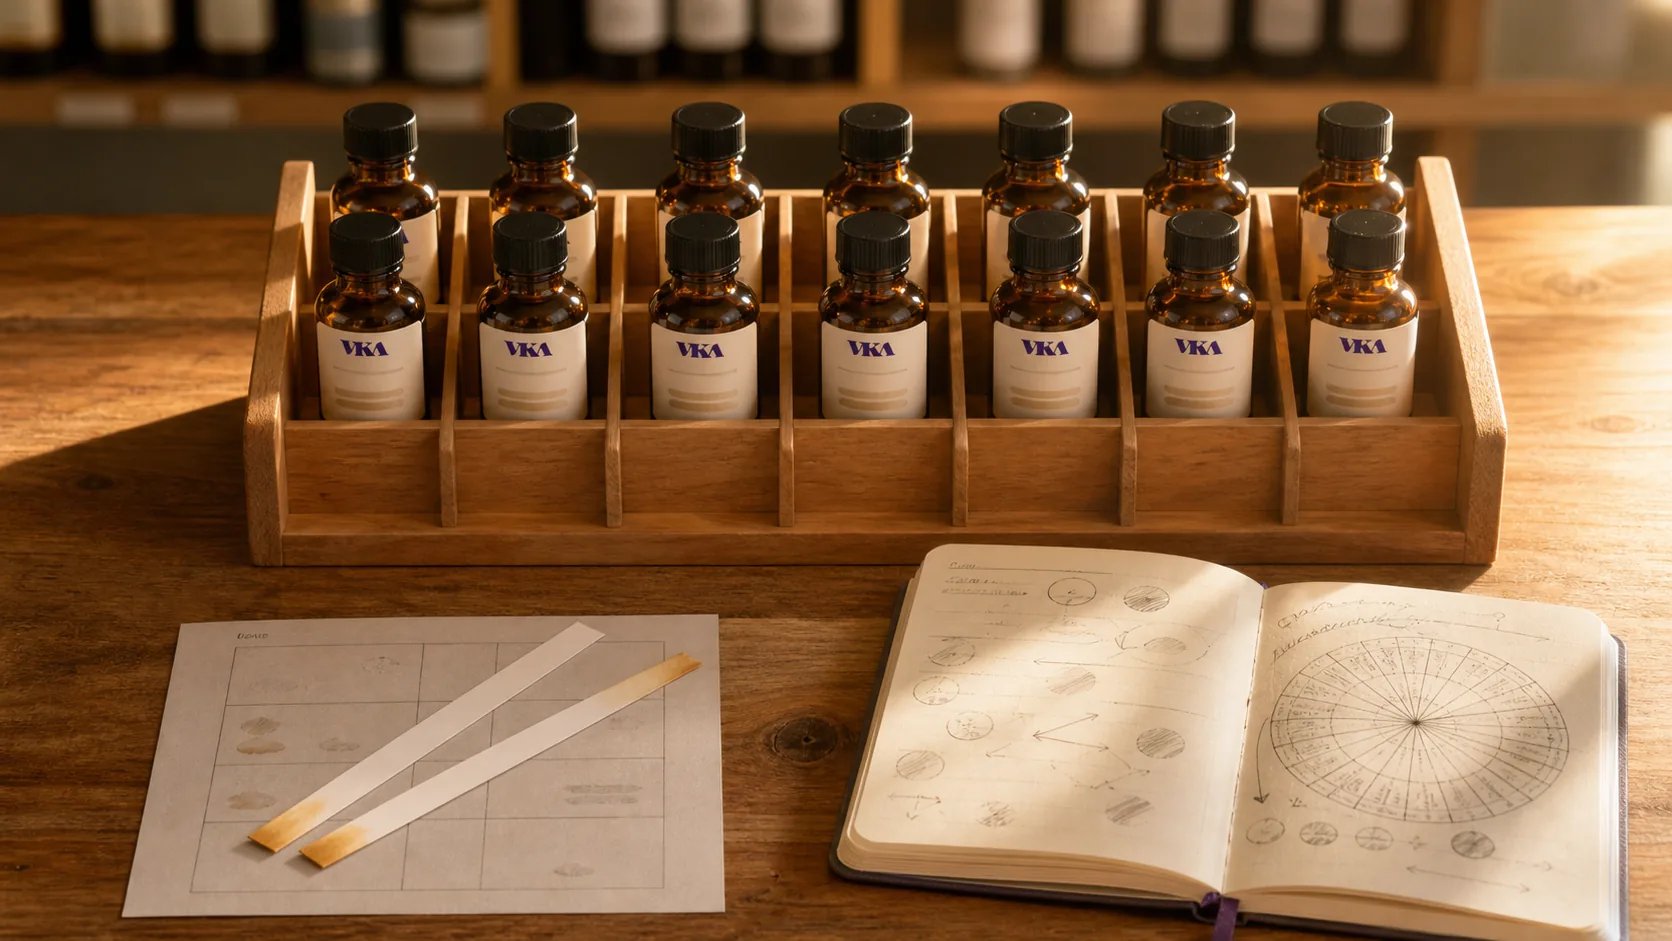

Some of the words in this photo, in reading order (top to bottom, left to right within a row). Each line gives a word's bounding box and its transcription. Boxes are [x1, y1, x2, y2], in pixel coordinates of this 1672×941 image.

[340, 339, 389, 356] VKA
[504, 340, 553, 358] VKA
[676, 341, 725, 359] VKA
[847, 340, 895, 357] VKA
[1021, 339, 1069, 357] VKA
[1174, 338, 1223, 356] VKA
[1339, 337, 1387, 354] VKA
